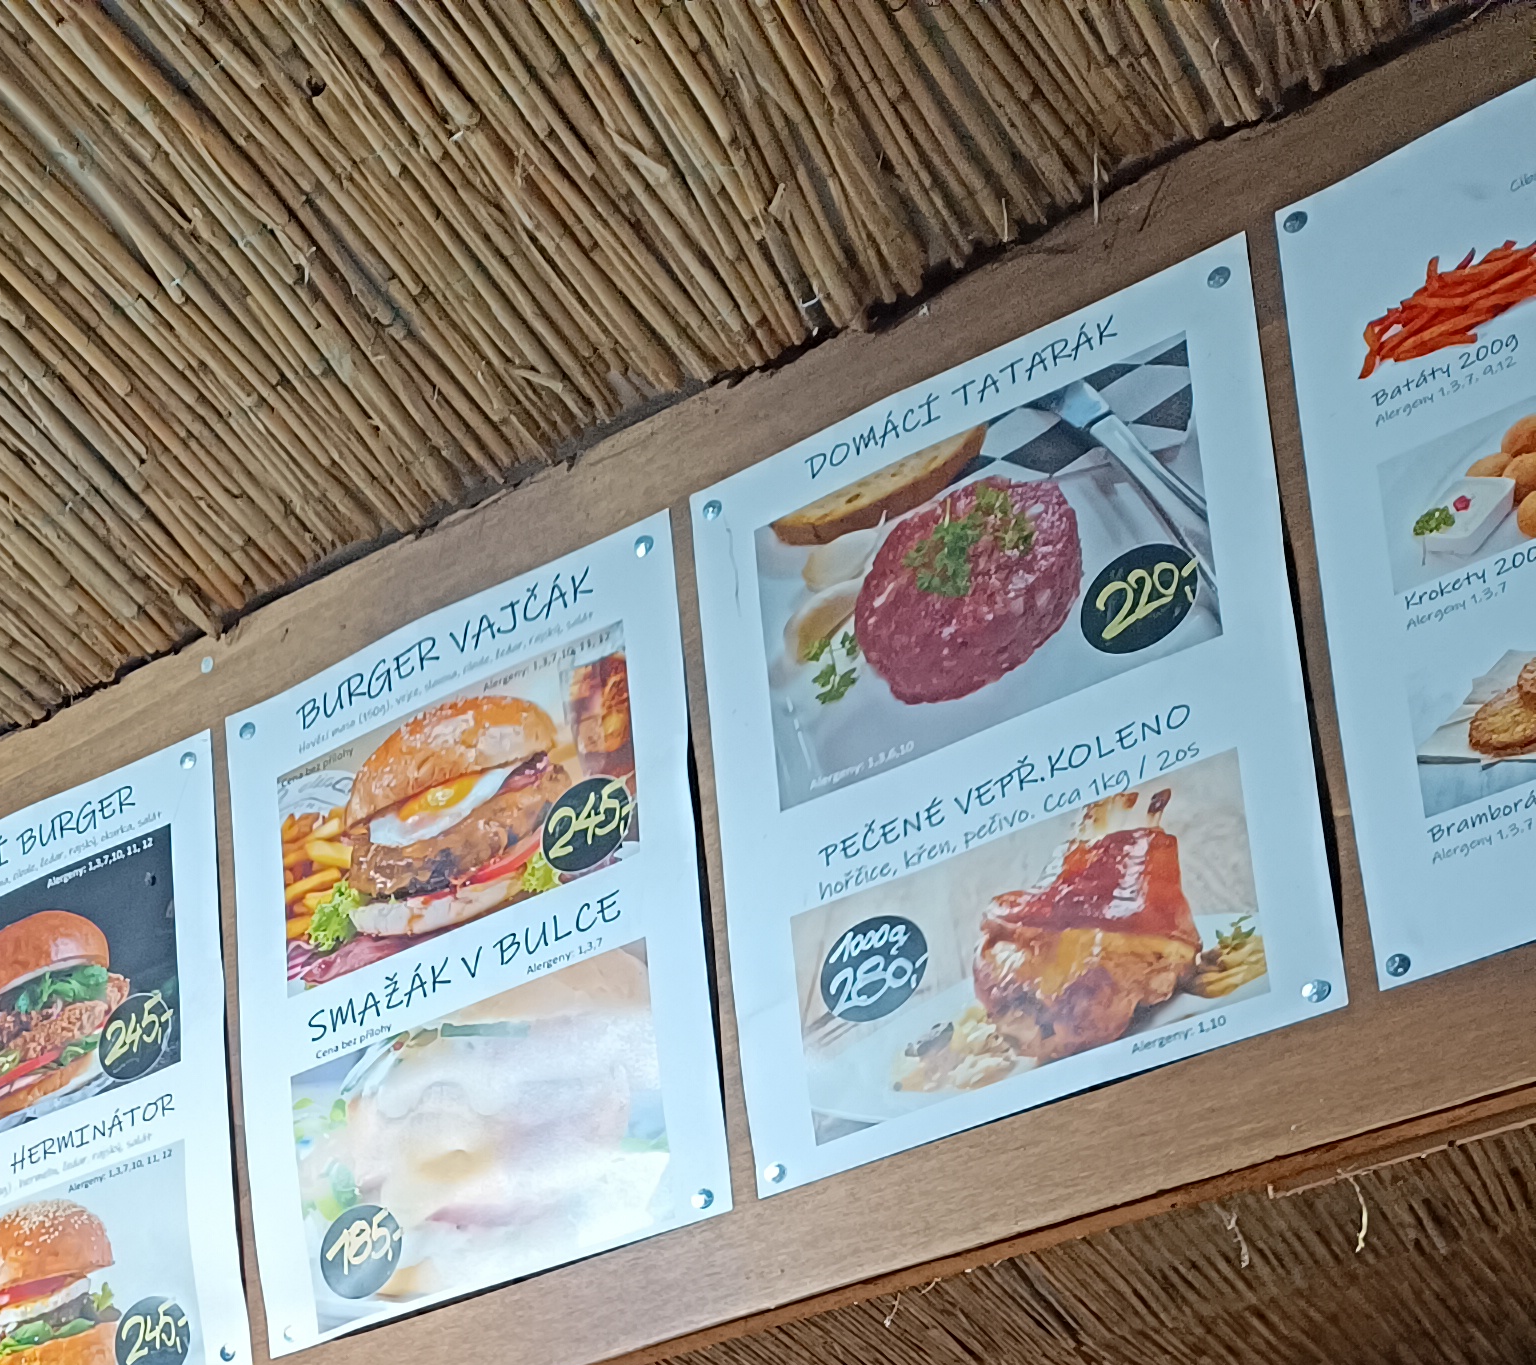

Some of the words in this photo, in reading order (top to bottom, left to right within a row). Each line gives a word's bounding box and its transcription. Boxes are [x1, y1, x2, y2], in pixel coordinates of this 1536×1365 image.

[804, 393, 943, 480] DOMÁCÍ
[952, 314, 1120, 407] TATARÁK
[1372, 362, 1451, 408] Batáty
[1459, 333, 1519, 370] 200g
[1404, 568, 1486, 610] Krokety
[296, 636, 440, 731] BURGER
[449, 565, 594, 654] VAJČÁK
[15, 785, 137, 855] BURGER
[817, 796, 947, 868] PEČENÉ
[307, 956, 451, 1042] SMAŽÁK
[461, 946, 483, 980] V
[493, 889, 623, 966] BULCE
[315, 1041, 339, 1060] Cena
[341, 1034, 358, 1052] bez
[359, 1022, 392, 1045] přílohy
[10, 1092, 176, 1174] HERMINÁTOR
